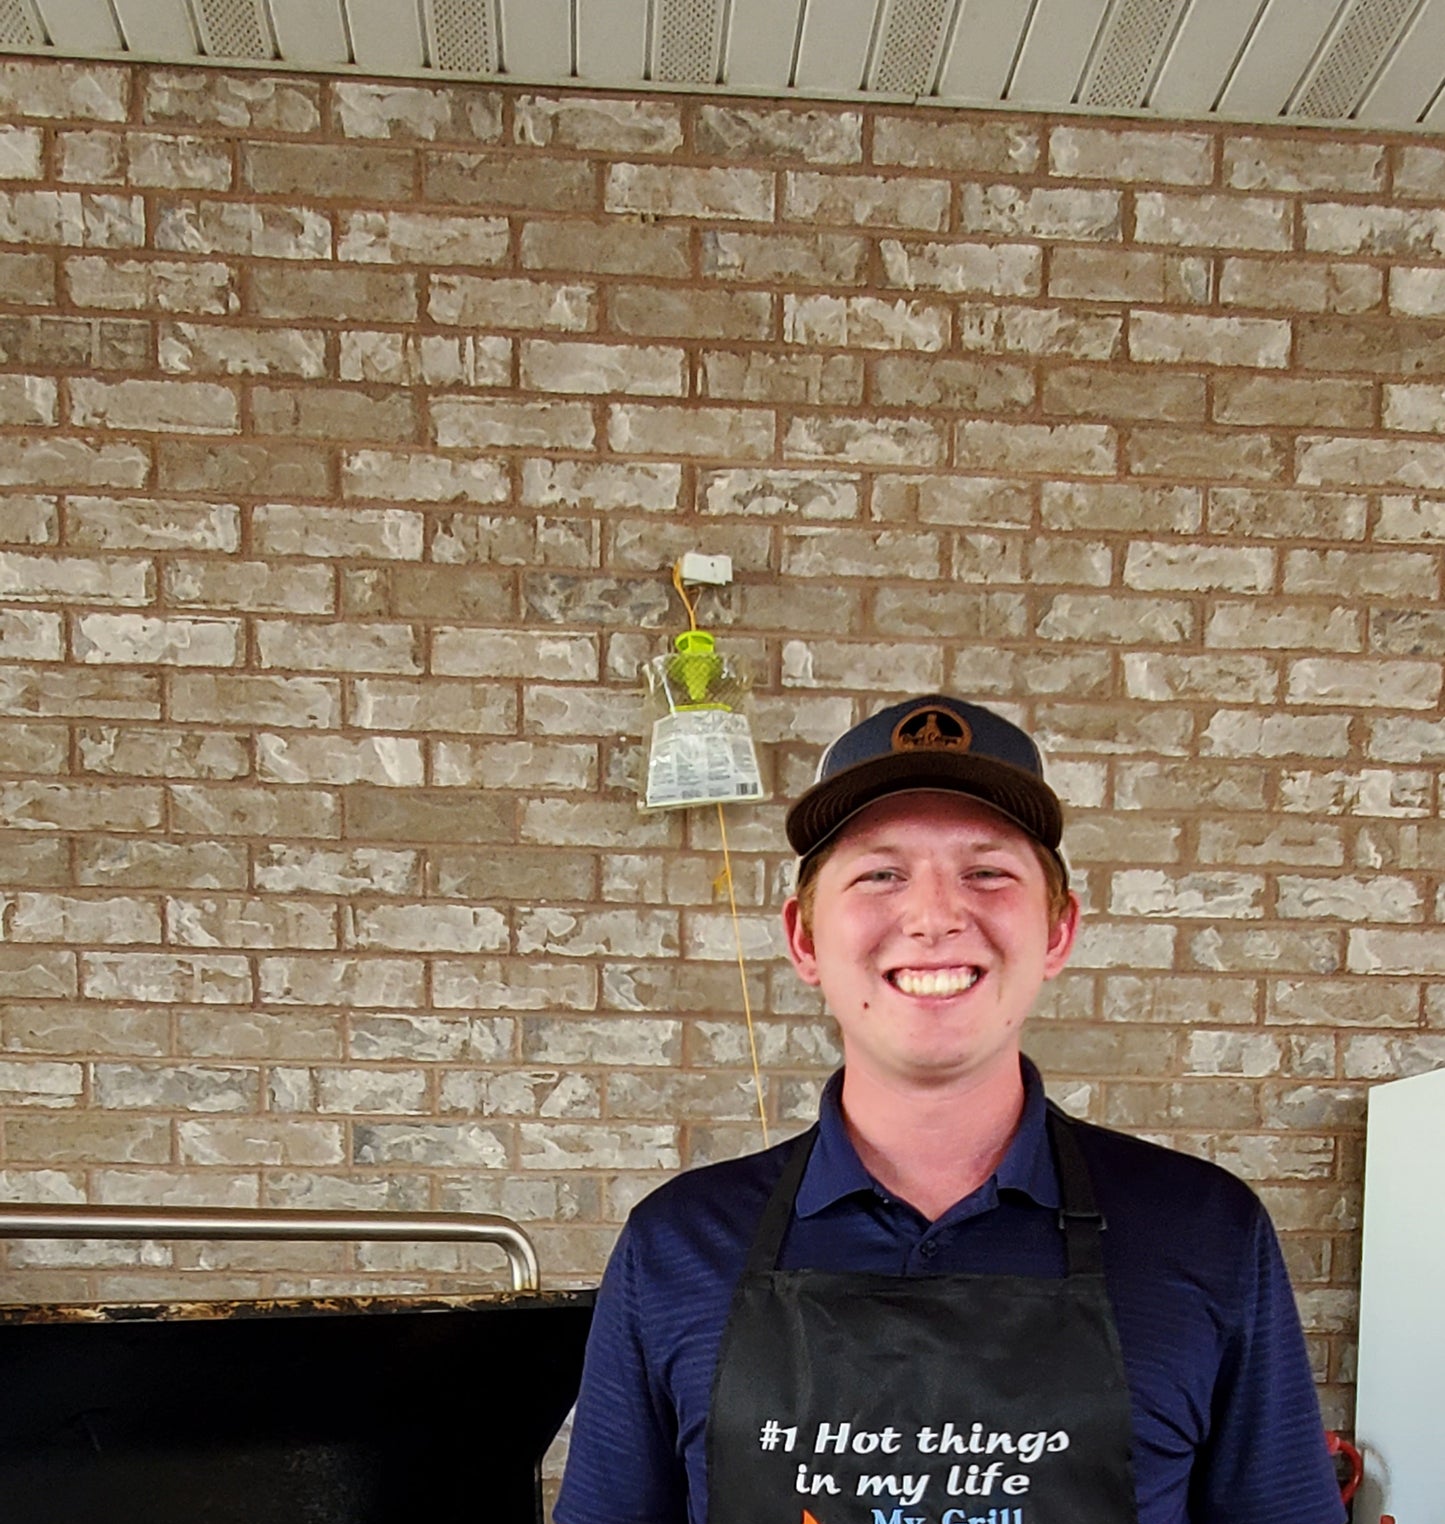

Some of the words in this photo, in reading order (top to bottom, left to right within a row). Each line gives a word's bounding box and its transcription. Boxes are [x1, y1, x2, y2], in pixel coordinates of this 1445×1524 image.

[759, 1419, 798, 1453] #1
[814, 1422, 902, 1455] Hot
[916, 1422, 1070, 1464] things
[795, 1463, 841, 1495] in
[856, 1474, 931, 1507] my
[946, 1461, 1030, 1496] life
